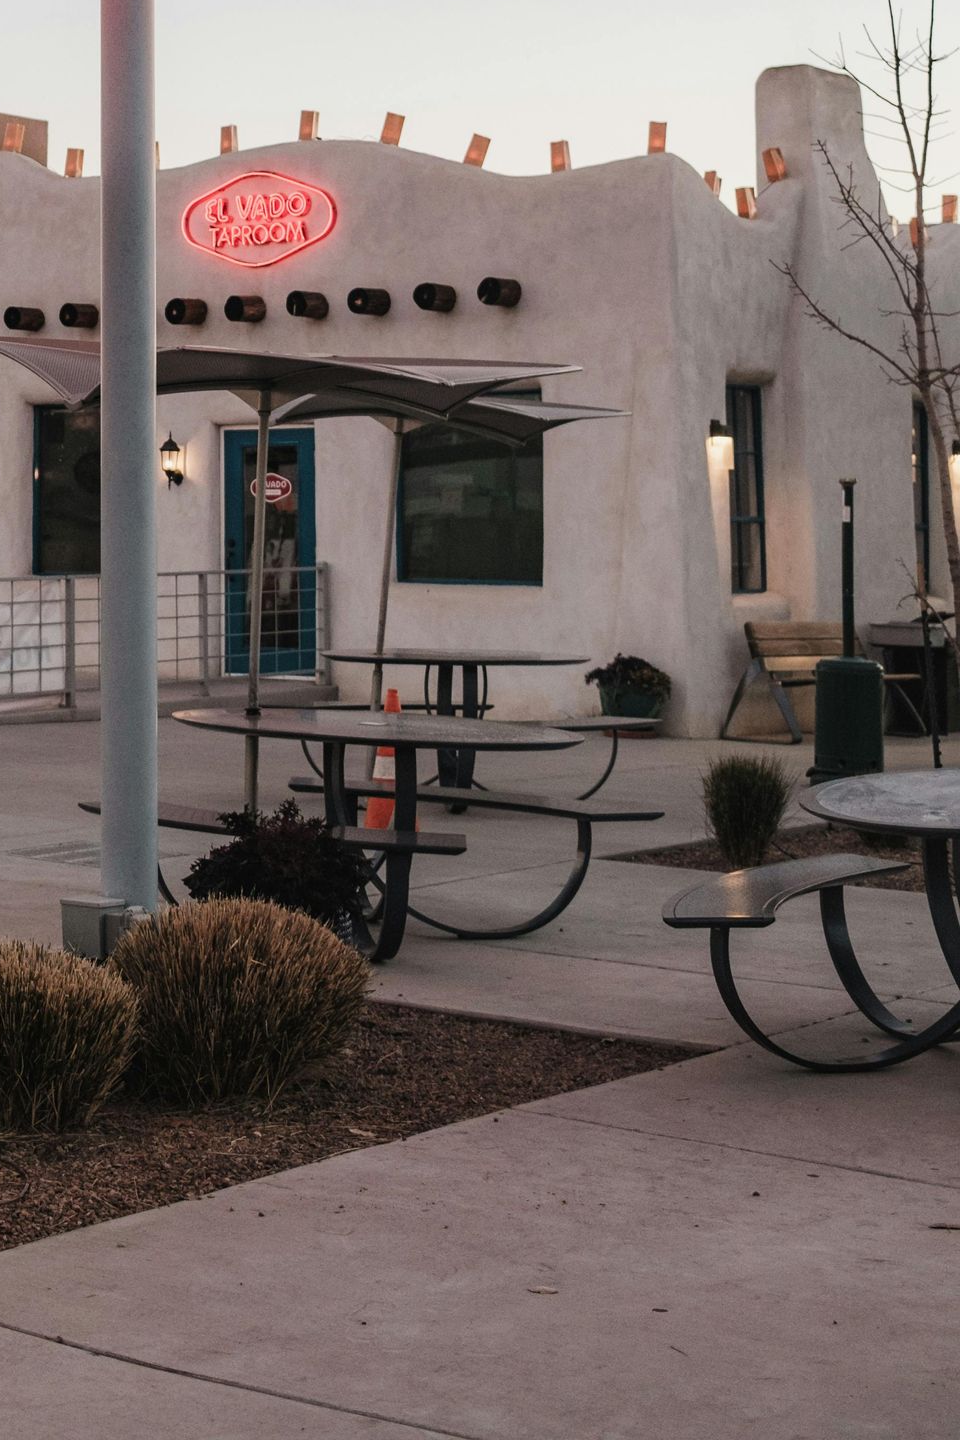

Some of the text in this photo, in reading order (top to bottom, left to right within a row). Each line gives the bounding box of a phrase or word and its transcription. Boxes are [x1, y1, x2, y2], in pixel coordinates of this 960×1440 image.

[205, 191, 308, 224] EL VADO
[208, 221, 306, 247] TAPROOM
